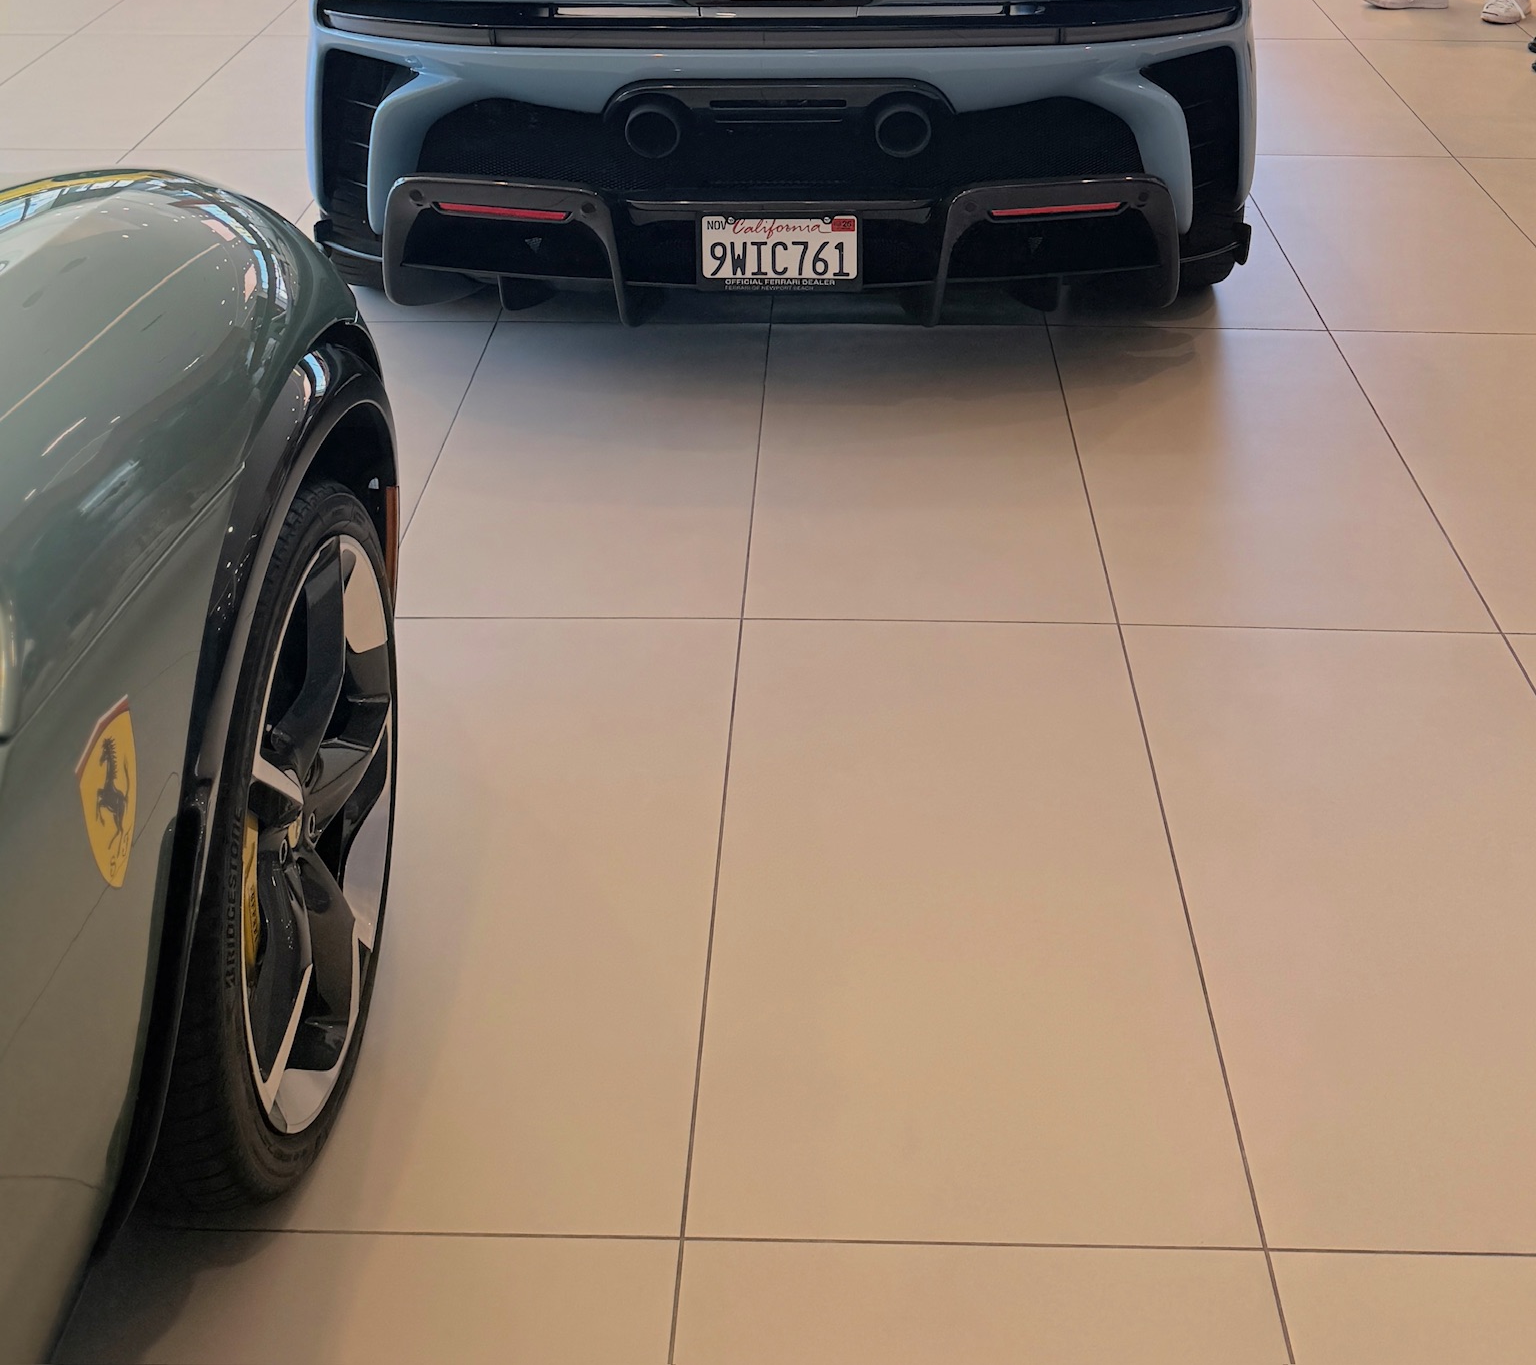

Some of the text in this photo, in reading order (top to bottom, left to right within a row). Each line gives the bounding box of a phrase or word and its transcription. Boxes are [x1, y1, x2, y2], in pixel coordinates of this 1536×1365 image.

[706, 220, 727, 231] NOV
[733, 219, 831, 239] California
[710, 241, 850, 277] 9WIC761
[802, 278, 835, 286] DEALER
